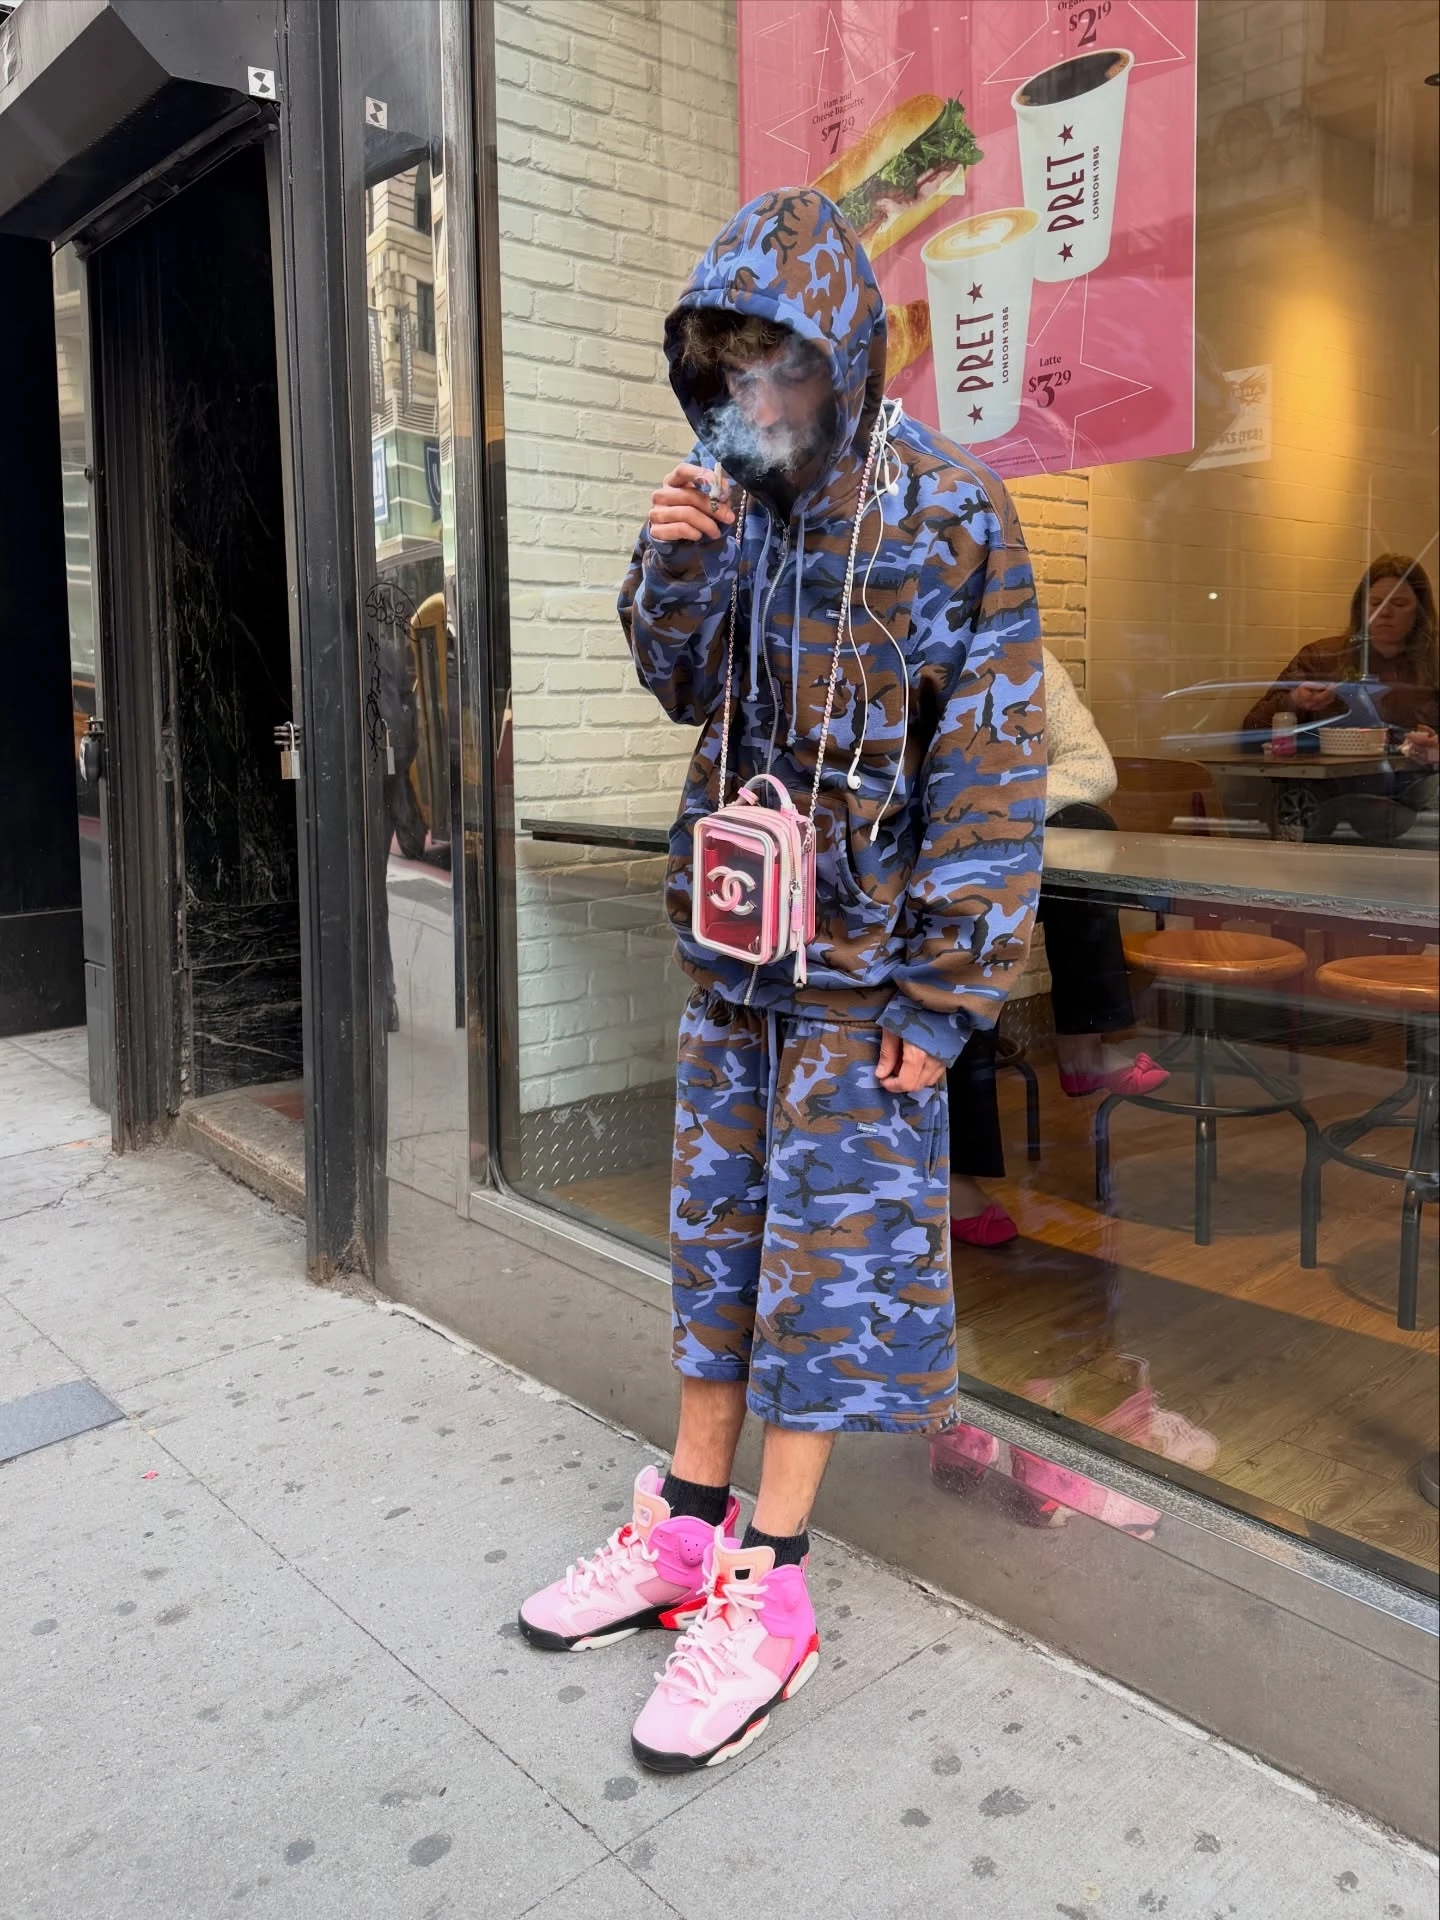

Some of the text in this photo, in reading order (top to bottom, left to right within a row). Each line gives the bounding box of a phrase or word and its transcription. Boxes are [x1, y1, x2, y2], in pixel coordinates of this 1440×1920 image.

[812, 97, 864, 124] Cheese Baguette
[824, 90, 852, 110] Ham and
[1047, 152, 1085, 232] PRET
[1092, 145, 1100, 220] LONDON 1986
[956, 312, 994, 393] PRET
[1040, 355, 1062, 367] Latte
